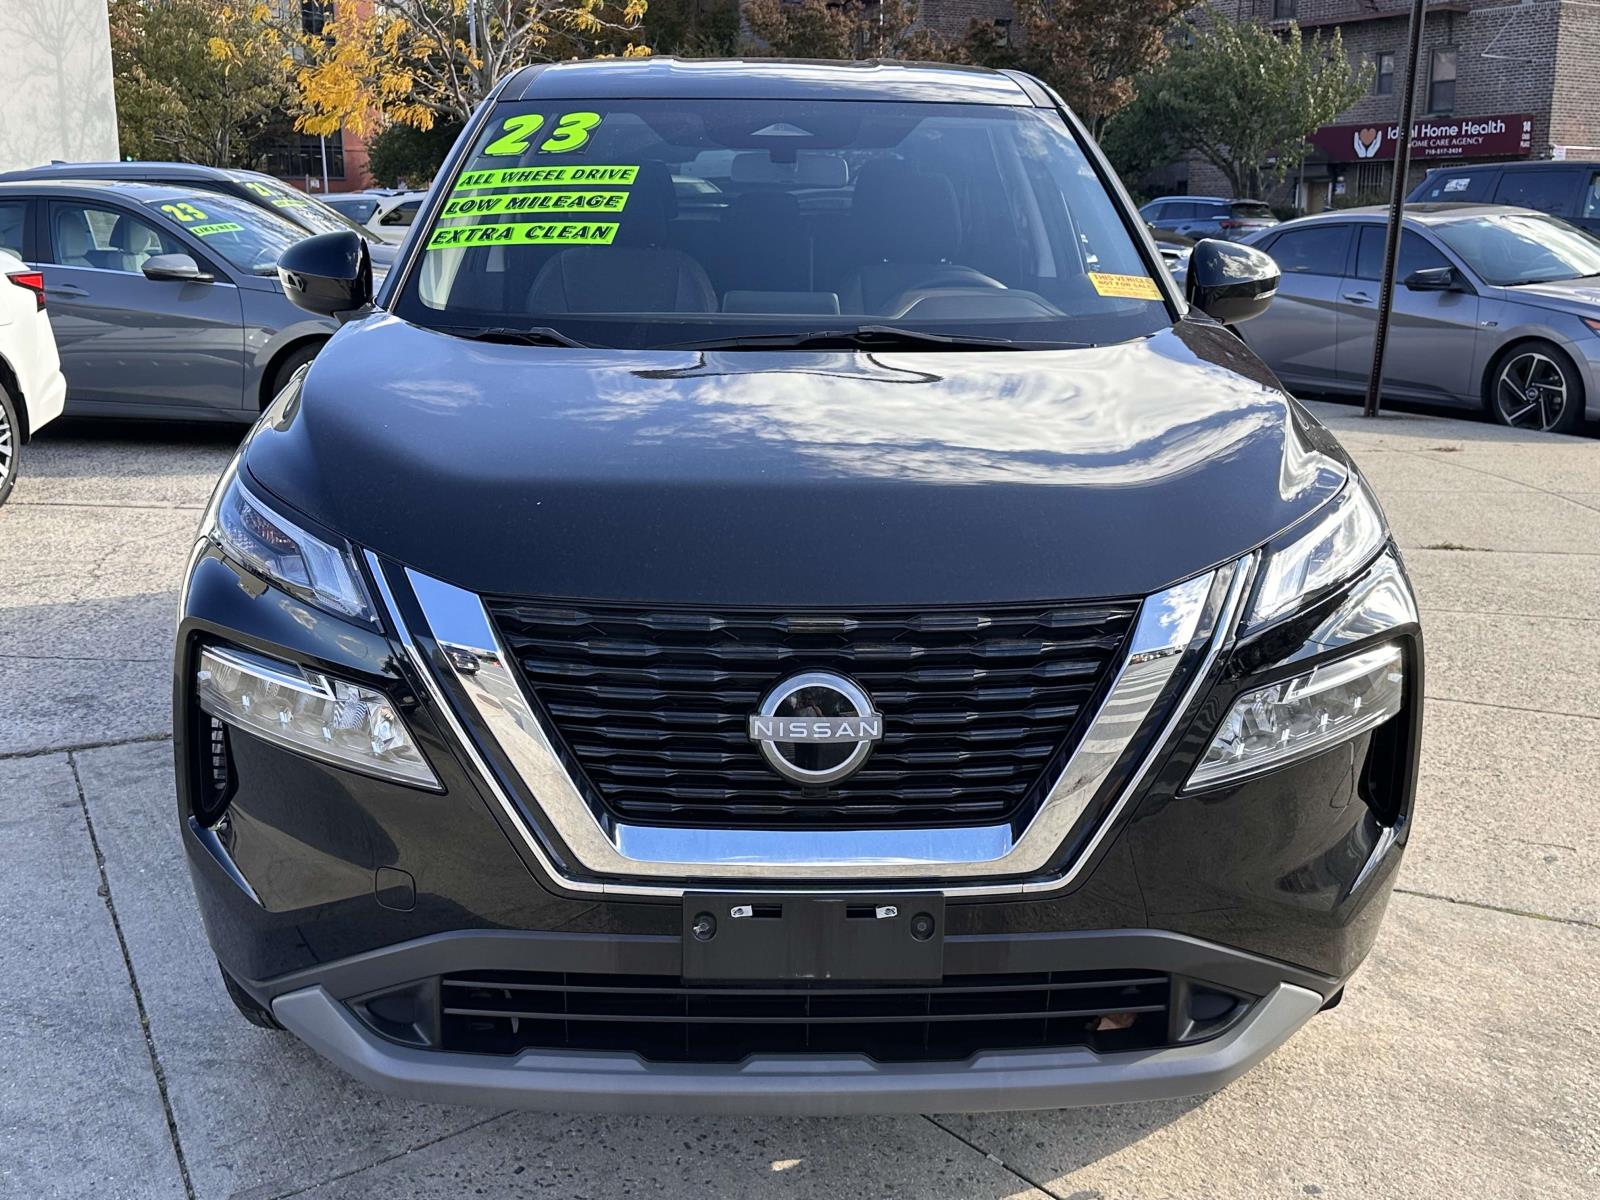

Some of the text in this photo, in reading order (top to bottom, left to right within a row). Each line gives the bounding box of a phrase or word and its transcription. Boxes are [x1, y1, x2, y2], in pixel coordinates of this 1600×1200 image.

[485, 112, 602, 156] 23
[1388, 120, 1505, 139] Idl Home Health
[1408, 136, 1484, 149] OME CARE AGENCY
[458, 167, 633, 187] ALL WHEEL DRIVE
[160, 202, 209, 222] 23
[445, 195, 622, 215] LOW MILEAGE
[431, 225, 613, 245] EXTRA CLEAN
[754, 720, 878, 738] NISSAN
